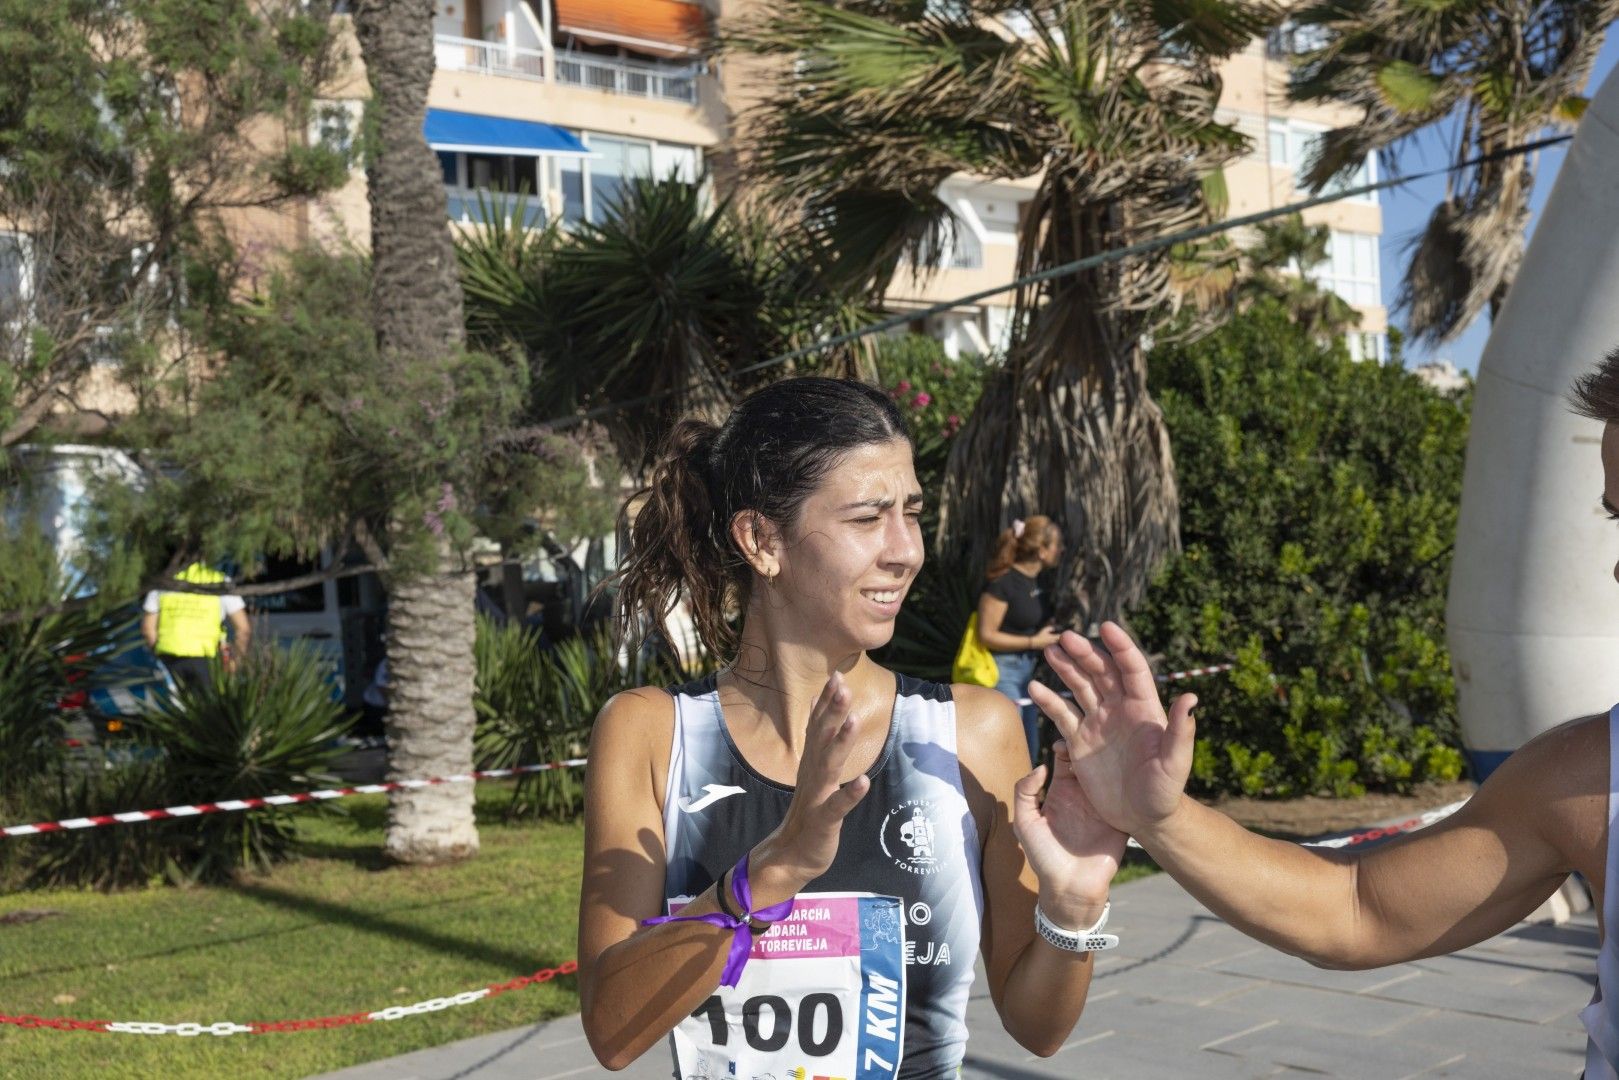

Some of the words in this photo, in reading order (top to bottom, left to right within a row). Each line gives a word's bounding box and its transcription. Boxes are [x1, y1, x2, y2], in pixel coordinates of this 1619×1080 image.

[894, 858, 949, 875] TORREVI
[761, 924, 808, 938] LIDARIA
[759, 938, 828, 953] TORREVIEJA
[865, 972, 899, 1042] KM
[690, 992, 844, 1057] 100
[864, 1048, 894, 1072] 7
